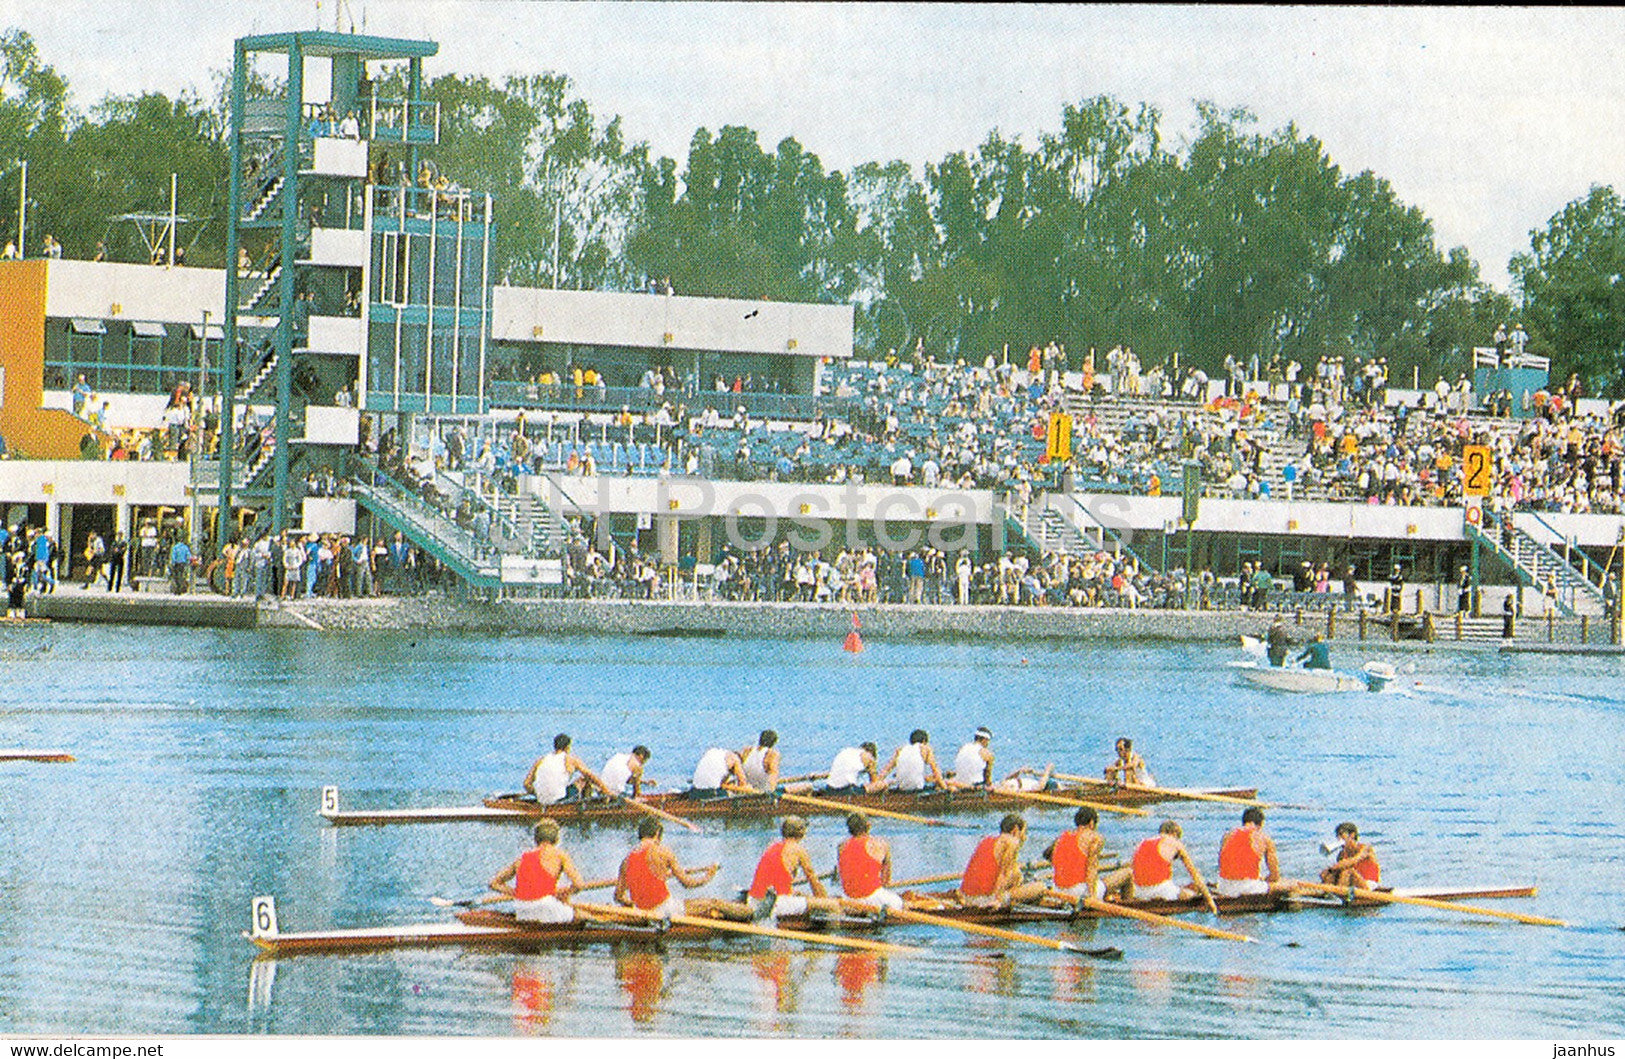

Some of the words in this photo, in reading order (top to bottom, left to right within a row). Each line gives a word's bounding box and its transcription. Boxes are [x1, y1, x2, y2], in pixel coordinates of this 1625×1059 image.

[1054, 418, 1062, 454] 1
[1468, 452, 1484, 489] 2
[325, 788, 336, 810] 5
[256, 901, 271, 931] 6
